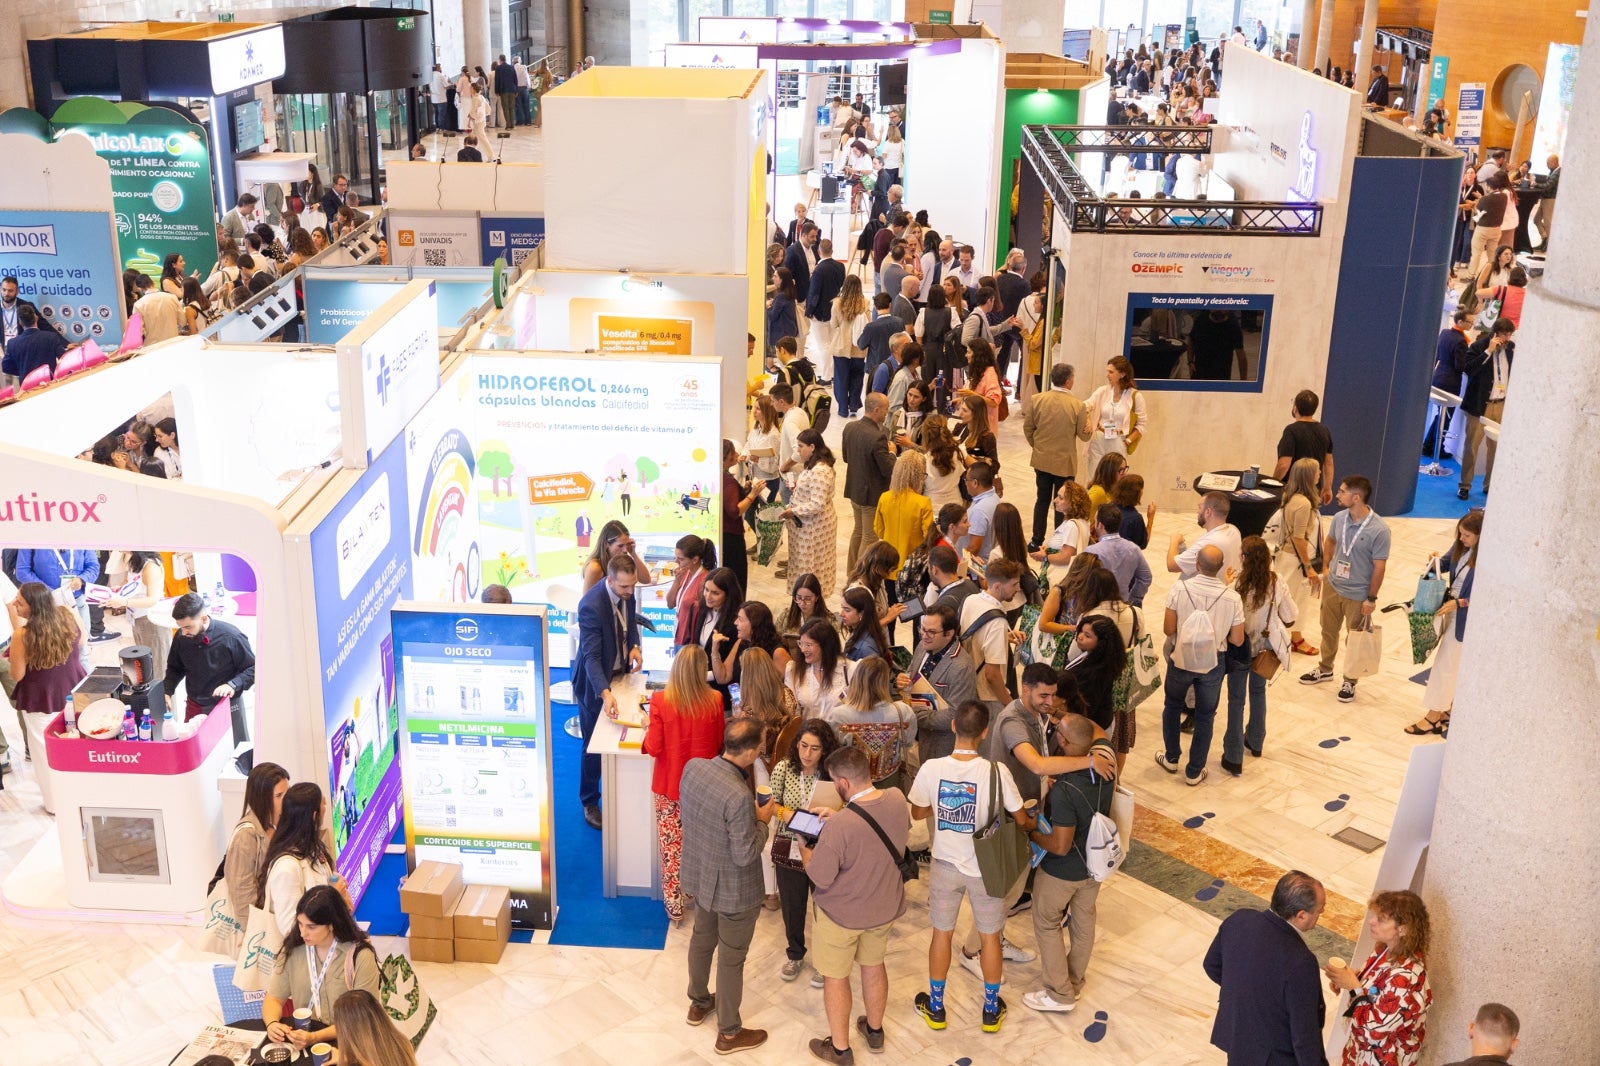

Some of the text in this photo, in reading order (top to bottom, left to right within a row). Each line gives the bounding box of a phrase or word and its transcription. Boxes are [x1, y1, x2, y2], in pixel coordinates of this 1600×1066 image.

[240, 64, 264, 80] ADAMED
[134, 156, 166, 168] LÍNEA
[138, 213, 162, 222] 94%
[0, 266, 91, 280] ogías que van
[18, 283, 92, 296] del cuidado
[1176, 297, 1202, 306] pantalla
[478, 374, 648, 396] HIDROFEROL 0,266 mg
[683, 379, 698, 390] 45
[478, 393, 536, 408] cápsulas
[541, 395, 596, 408] blandas
[602, 398, 649, 410] Calcifediol
[554, 423, 599, 431] tratamiento
[534, 489, 542, 497] la
[444, 647, 491, 656] OJO SECO
[439, 723, 504, 734] NETILMICINA
[938, 804, 976, 823] PATAGONIA
[424, 837, 472, 847] CORTICOIDE
[486, 840, 533, 849] SUPERFICIE
[205, 1026, 236, 1036] IDEAL
